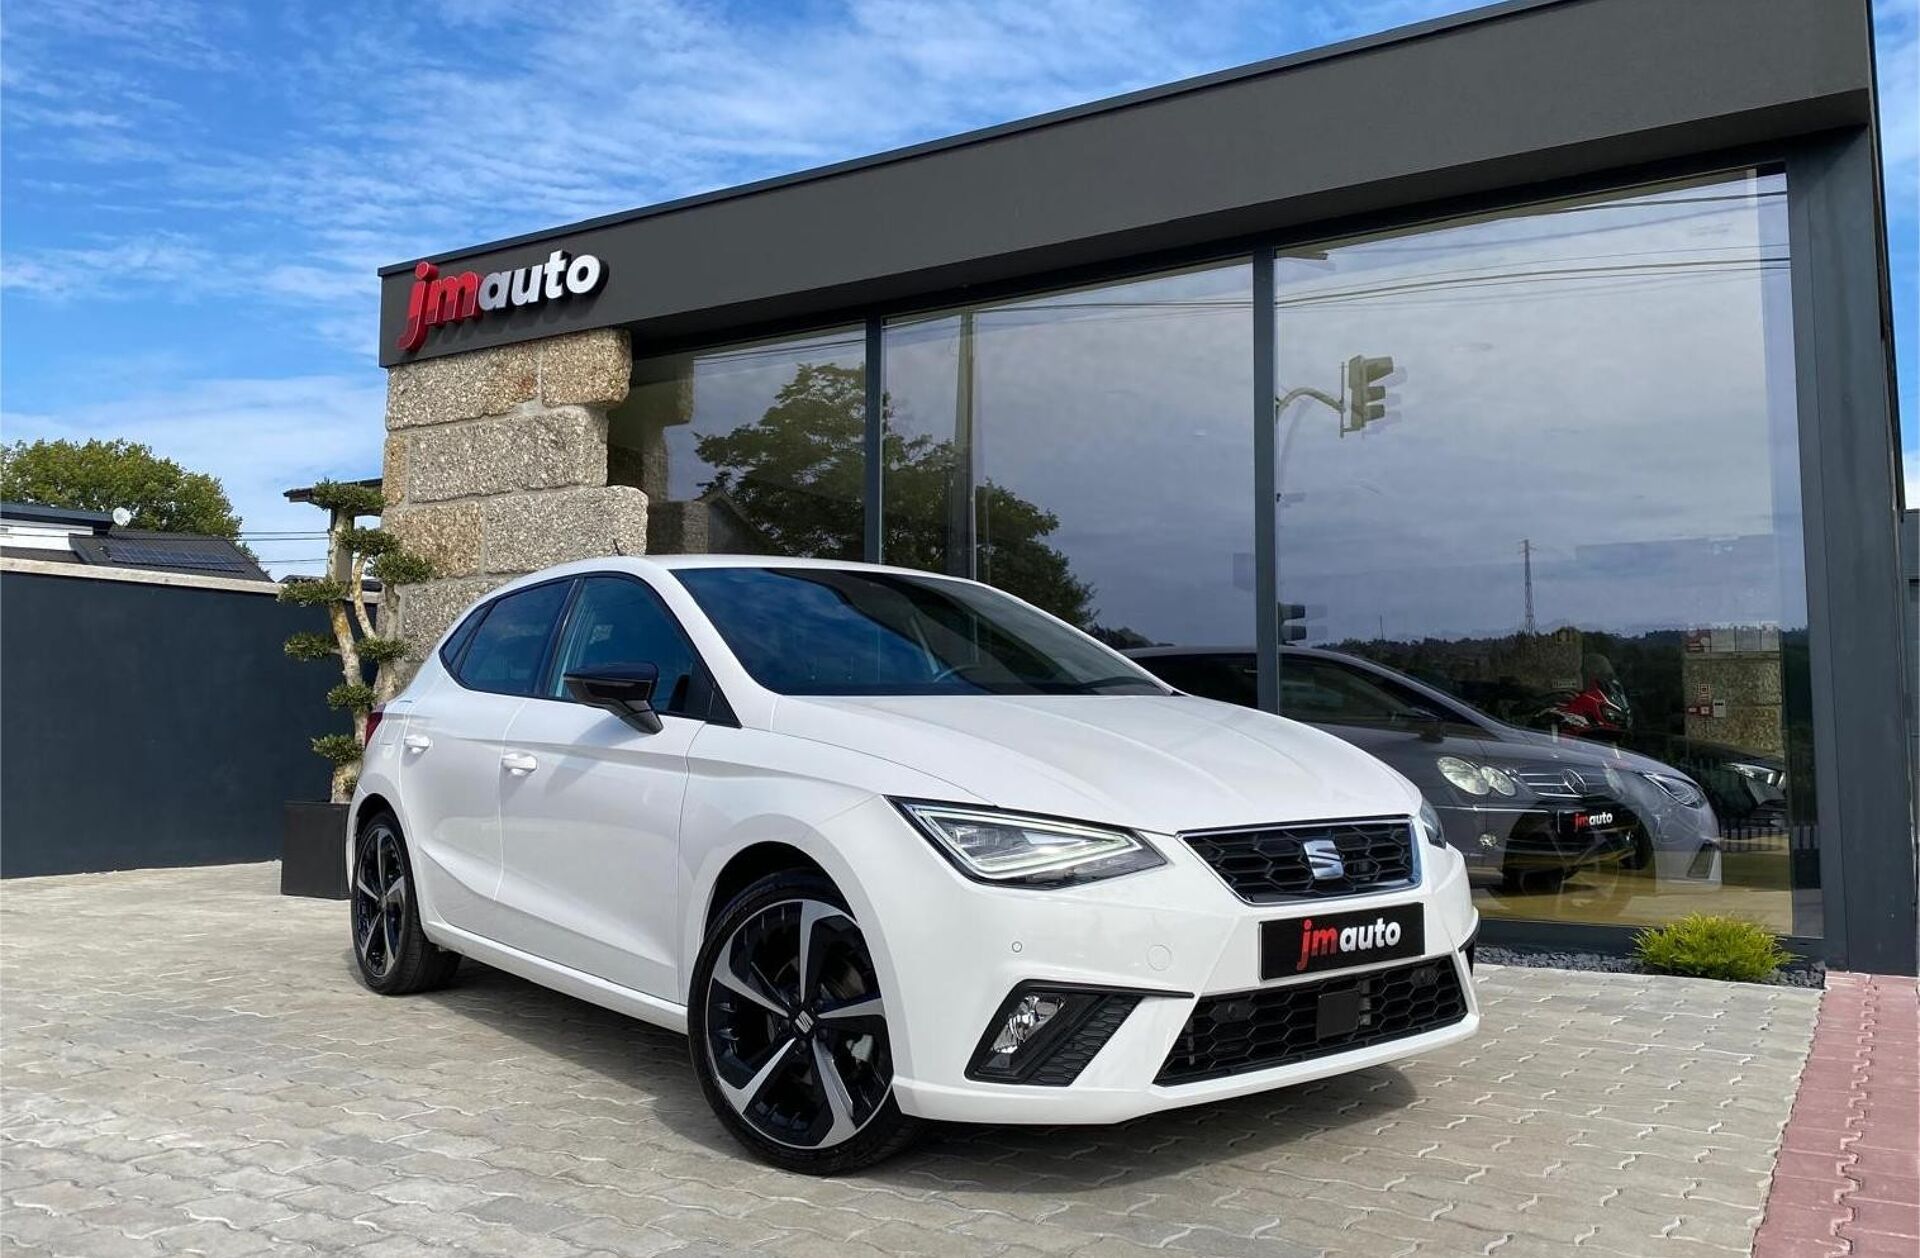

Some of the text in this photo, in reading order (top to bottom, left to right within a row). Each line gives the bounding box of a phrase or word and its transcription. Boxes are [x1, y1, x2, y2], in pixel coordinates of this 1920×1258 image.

[396, 250, 604, 349] jmauto
[1575, 811, 1613, 832] jmauto
[1296, 917, 1401, 971] jmauto
